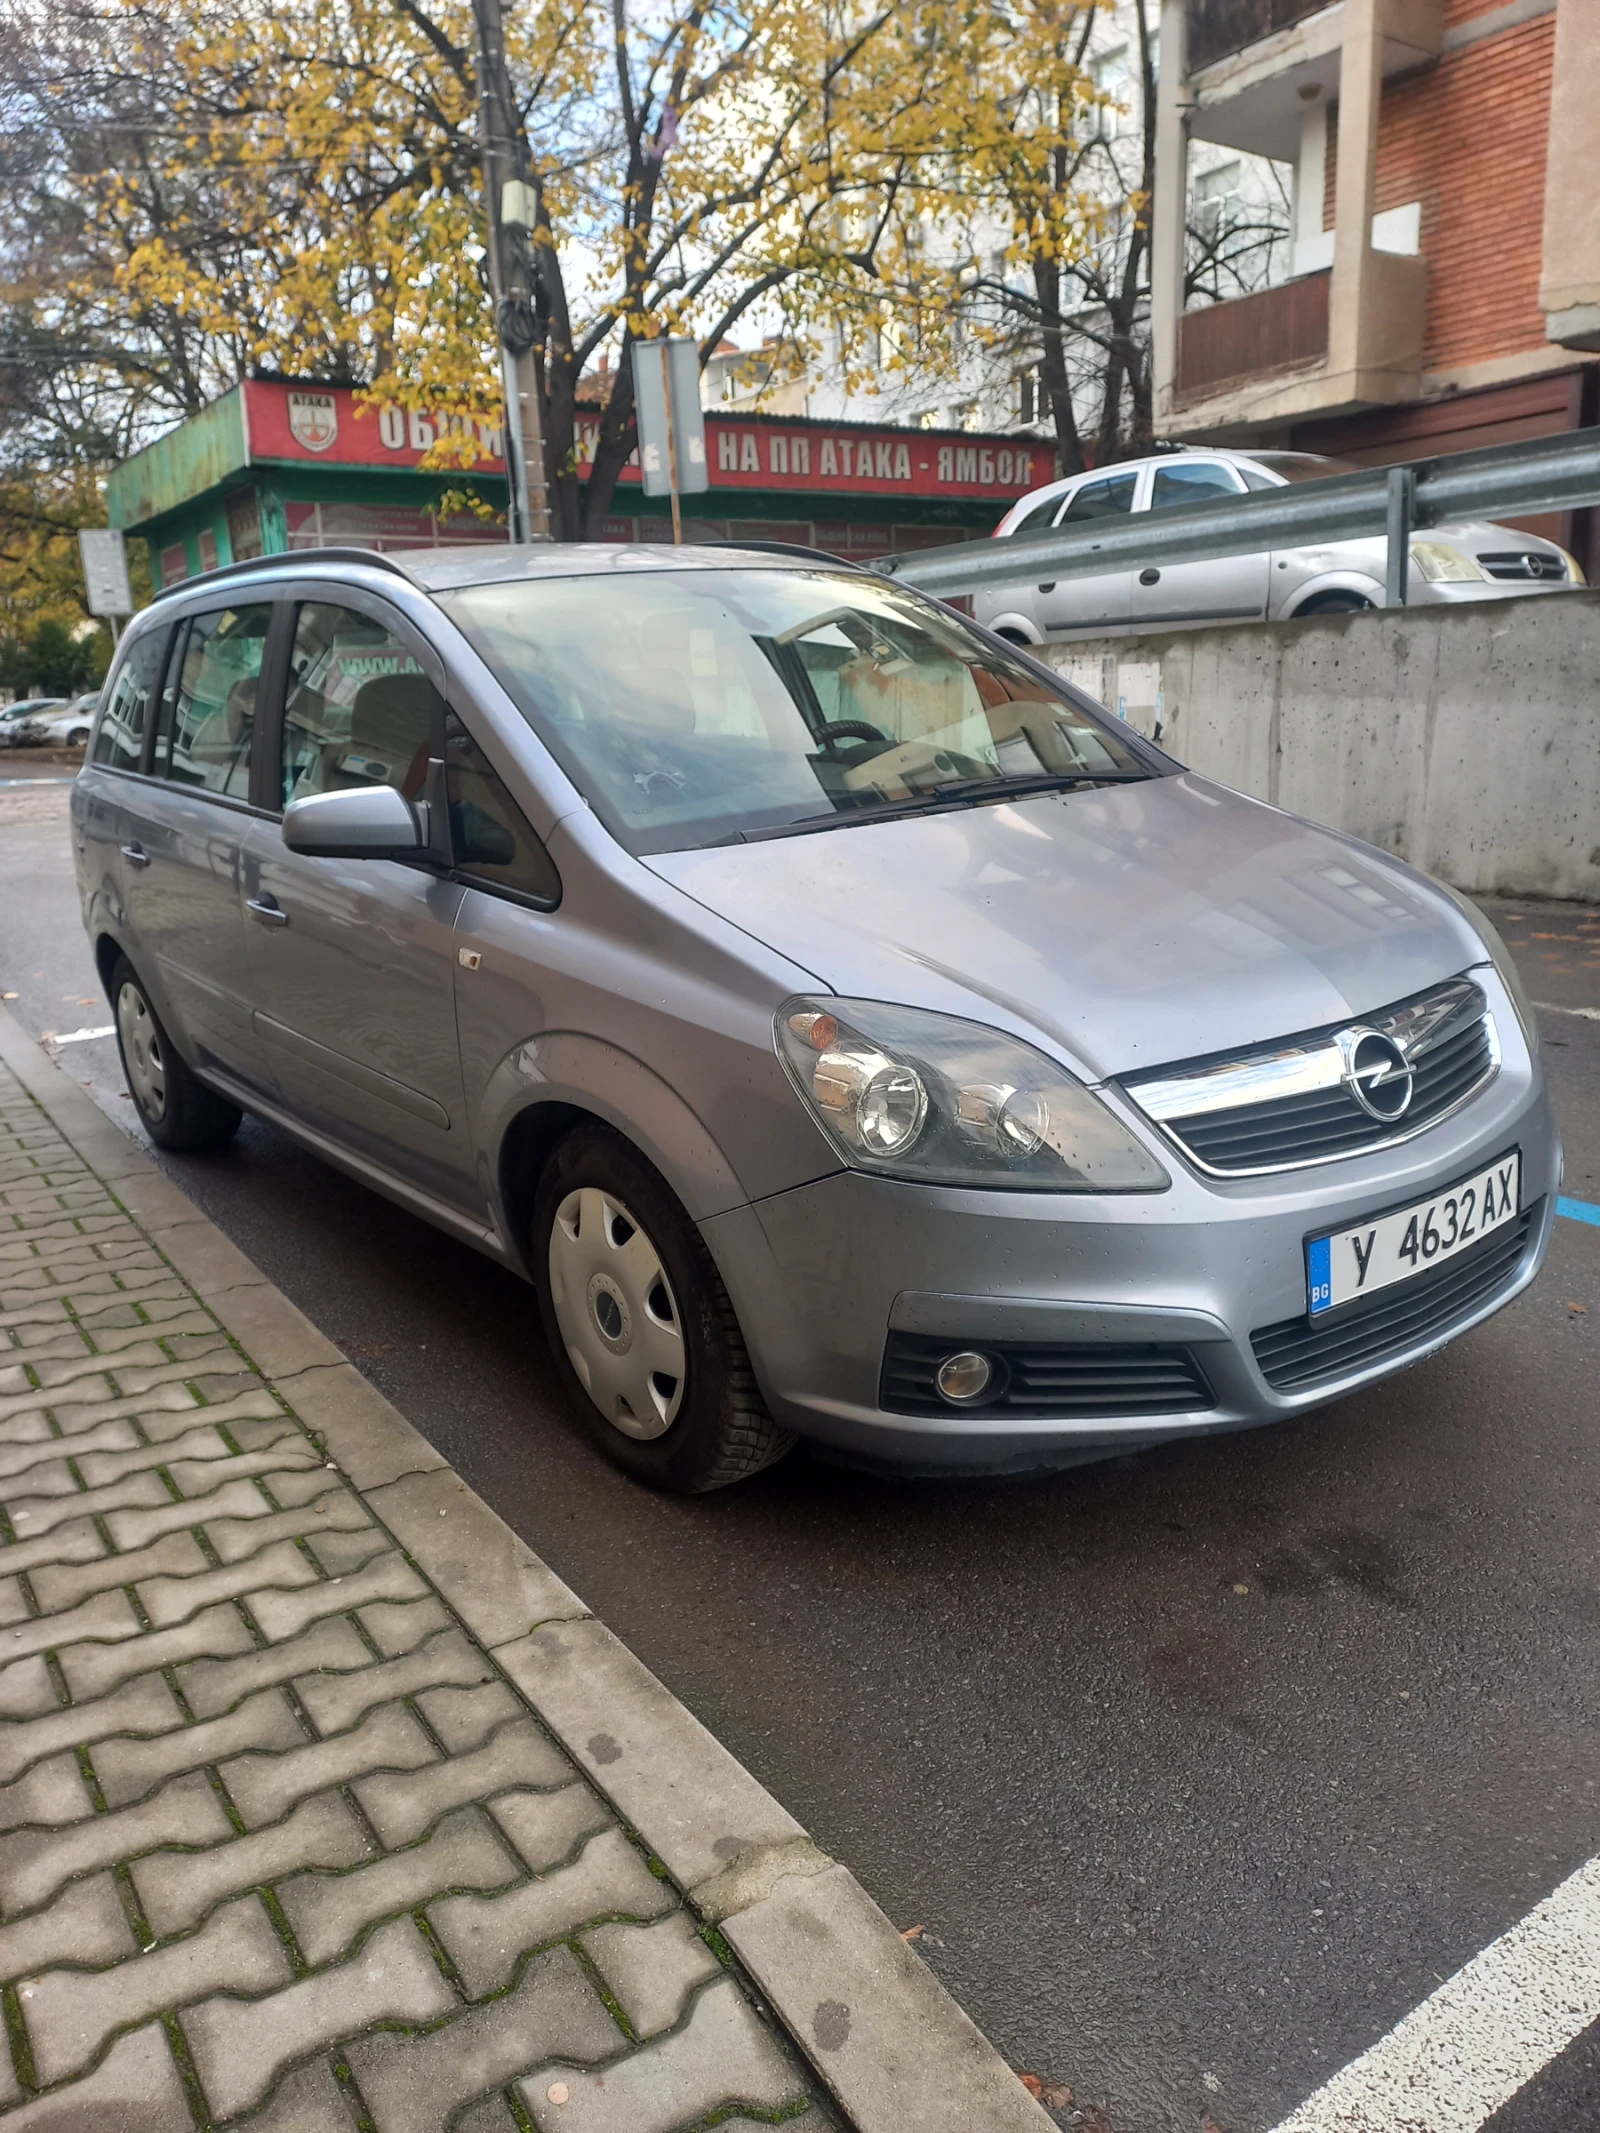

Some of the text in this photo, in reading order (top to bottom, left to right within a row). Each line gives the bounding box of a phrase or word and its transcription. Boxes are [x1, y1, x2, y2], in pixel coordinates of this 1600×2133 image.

[292, 394, 332, 408] АТАКА
[718, 432, 760, 472] НА
[769, 435, 810, 474] ПП
[820, 438, 912, 480] АТАКА
[919, 462, 929, 470] -
[937, 446, 1032, 485] ЯМБОЛ
[337, 656, 424, 675] WWW.A
[1312, 1283, 1329, 1304] BG
[1398, 1188, 1476, 1266] 4632
